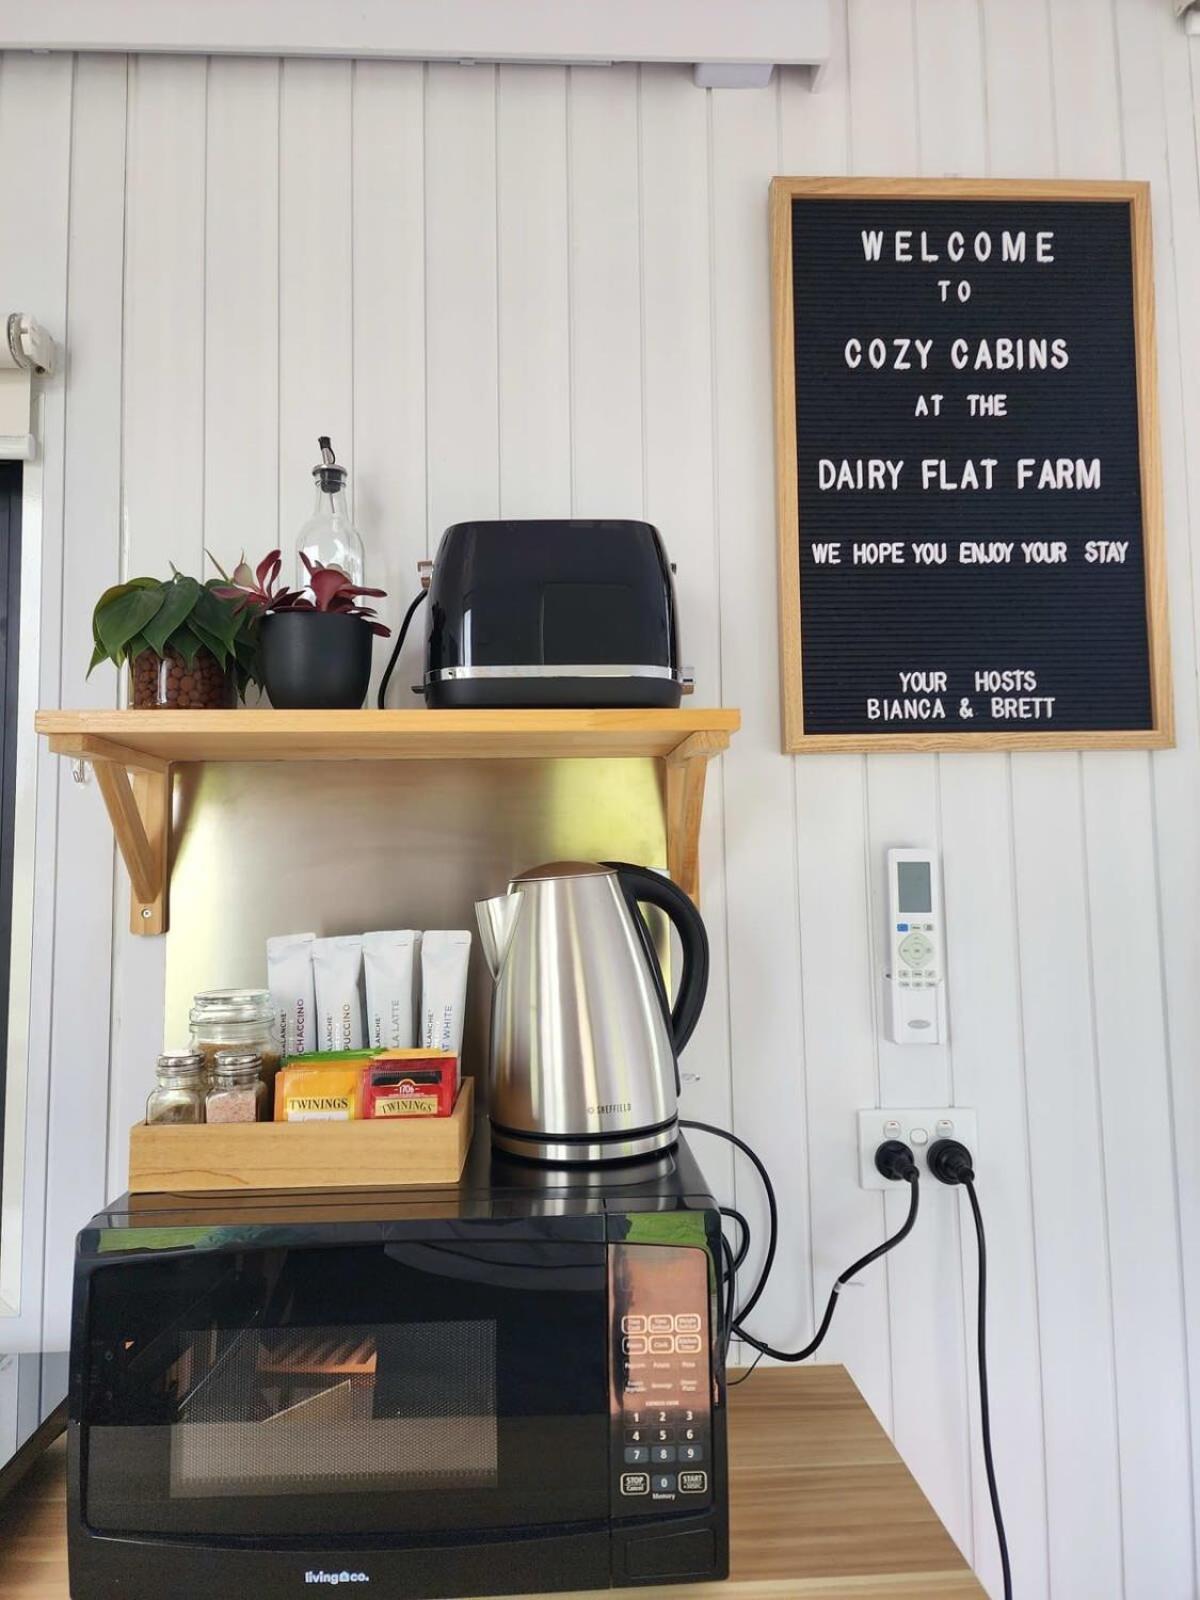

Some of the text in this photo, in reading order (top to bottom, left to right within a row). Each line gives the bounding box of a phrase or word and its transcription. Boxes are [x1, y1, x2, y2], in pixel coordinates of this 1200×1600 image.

[861, 230, 1055, 264] WELCOME
[937, 280, 971, 303] TO
[844, 337, 1069, 371] COZY CABINS
[914, 393, 1008, 417] AT THE
[818, 458, 1101, 491] DAIRY FLAT FARM
[811, 540, 1129, 565] WE HOPE YOU ENJOY YOUR STAY
[898, 669, 1037, 694] YOUR HOSTS
[866, 696, 1056, 721] BIANCA & BRETT
[296, 998, 305, 1056] CHACCINO
[343, 1003, 351, 1051] PUCCINO
[289, 1097, 349, 1111] TWININGS
[381, 1099, 433, 1116] TWININGS
[633, 1412, 639, 1423] 1
[659, 1412, 666, 1422] 2
[686, 1411, 693, 1421] 3
[632, 1430, 640, 1441] 4
[659, 1430, 667, 1440] 5
[686, 1429, 694, 1439] 6
[633, 1450, 640, 1460] 7
[660, 1449, 667, 1459] 8
[687, 1449, 694, 1458] 9
[660, 1478, 668, 1488] 0
